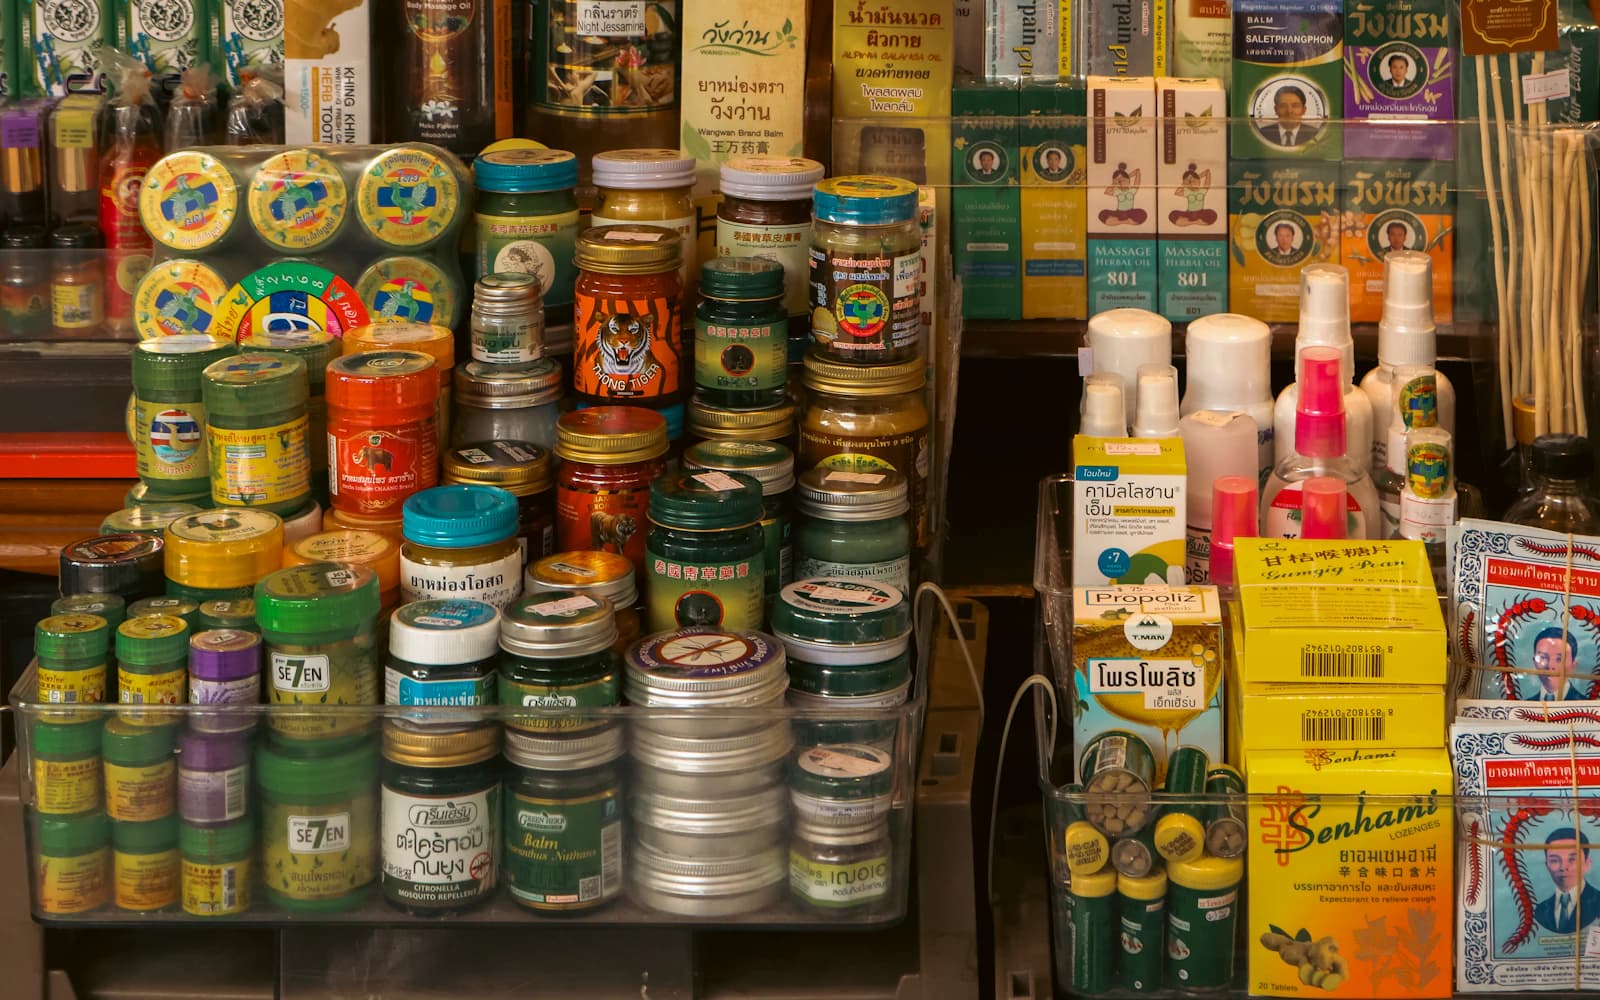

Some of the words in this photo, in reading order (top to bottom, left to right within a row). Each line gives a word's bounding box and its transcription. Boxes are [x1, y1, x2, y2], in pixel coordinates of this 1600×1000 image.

[583, 2, 640, 22] กลิ่นราตรี
[848, 1, 941, 25] น้ำมันนวด
[1247, 16, 1273, 24] BALM
[578, 22, 600, 37] Night
[602, 22, 645, 35] Jessamine
[702, 19, 770, 46] วังว่าน
[866, 28, 922, 49] ผิวกาย
[1245, 35, 1334, 44] SALETPHANGPHON
[321, 67, 334, 103] HERB
[343, 67, 356, 107] KHING
[697, 75, 785, 98] ยาหม่องตรา
[709, 97, 771, 121] วังว่าน
[343, 114, 356, 144] KHIN
[698, 128, 736, 139] Wangwan
[738, 127, 761, 138] Brand
[764, 127, 785, 138] Balm
[711, 140, 771, 155] 王万药膏
[1095, 248, 1152, 260] MASSAGE
[1165, 248, 1222, 260] MASSAGE
[1096, 259, 1129, 267] HERBAL
[1134, 259, 1151, 267] OIL
[1166, 259, 1199, 267] HERBAL
[1203, 259, 1221, 268] OIL
[1107, 272, 1138, 287] 801
[1177, 272, 1208, 287] 801
[1185, 307, 1200, 315] 801
[592, 362, 626, 391] THONG
[629, 363, 660, 388] TIGER
[1085, 499, 1112, 516] เอ็ม
[411, 574, 504, 592] ยาหม่องโอสถ
[1489, 565, 1598, 588] ยาอมแก้ไอตราะขาบ
[1096, 592, 1197, 605] Propoliz
[1131, 634, 1165, 642] T.MAN
[278, 659, 323, 688] SE7EN
[1318, 750, 1397, 764] Senhami
[1487, 760, 1600, 780] ยาอมแก้ไอตราตขาบ
[1274, 789, 1438, 854] Senhami
[296, 819, 345, 849] SE7EN
[1388, 820, 1441, 841] LOZENGES
[524, 832, 559, 850] Balm
[414, 883, 461, 892] CITRONELLA
[1293, 879, 1372, 893] บรรเทาอาการไอ
[398, 889, 436, 901] MOSQUITO
[438, 888, 478, 901] REPELLENT
[1319, 895, 1367, 904] Expectorant
[1411, 895, 1437, 905] cough
[1258, 981, 1268, 990] 20
[1271, 983, 1298, 992] Tablets
